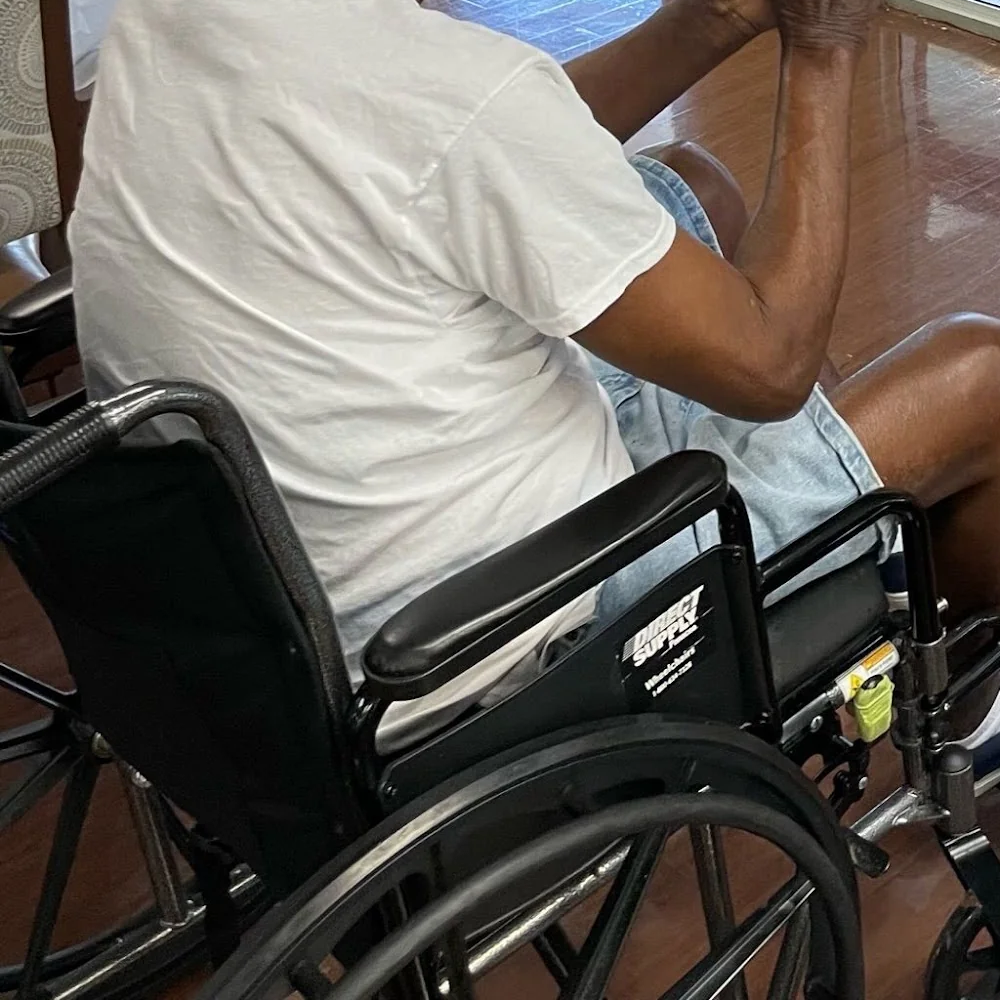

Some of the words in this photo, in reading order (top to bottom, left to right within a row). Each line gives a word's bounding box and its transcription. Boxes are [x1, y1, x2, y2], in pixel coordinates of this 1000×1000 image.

[632, 605, 699, 667] SUPPLY
[633, 584, 704, 653] DIRECT
[644, 646, 696, 691] Wheelchairs
